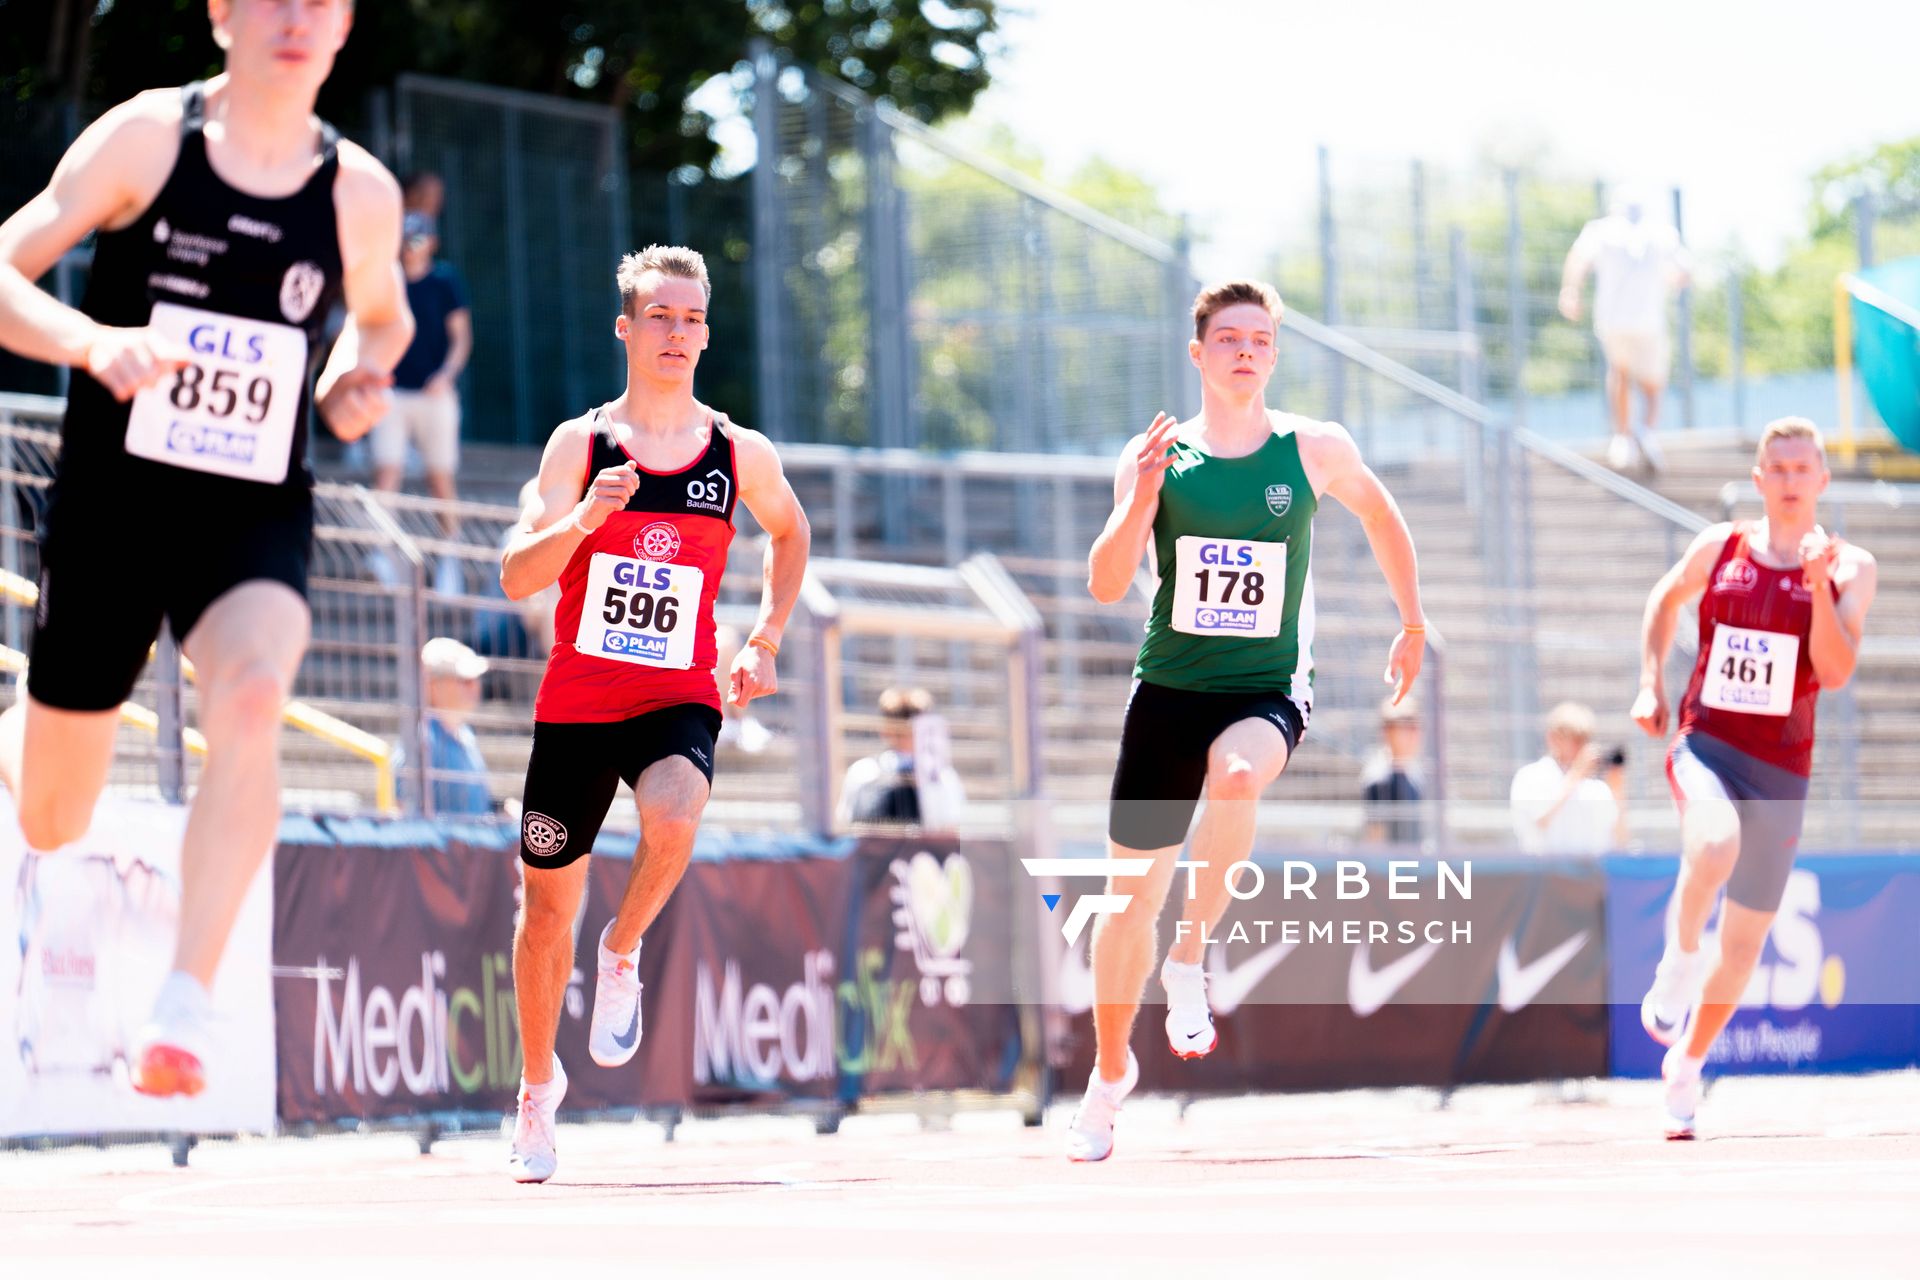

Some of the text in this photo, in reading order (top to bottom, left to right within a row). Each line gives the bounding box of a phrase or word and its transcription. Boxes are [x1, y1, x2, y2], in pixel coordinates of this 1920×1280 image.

[169, 363, 273, 424] 859
[687, 480, 718, 501] OS
[686, 499, 723, 513] BauImmo
[1195, 569, 1264, 606] 178
[602, 586, 679, 633] 596
[1220, 611, 1255, 624] PLAN
[628, 637, 666, 653] PLAN
[1720, 656, 1773, 686] 461
